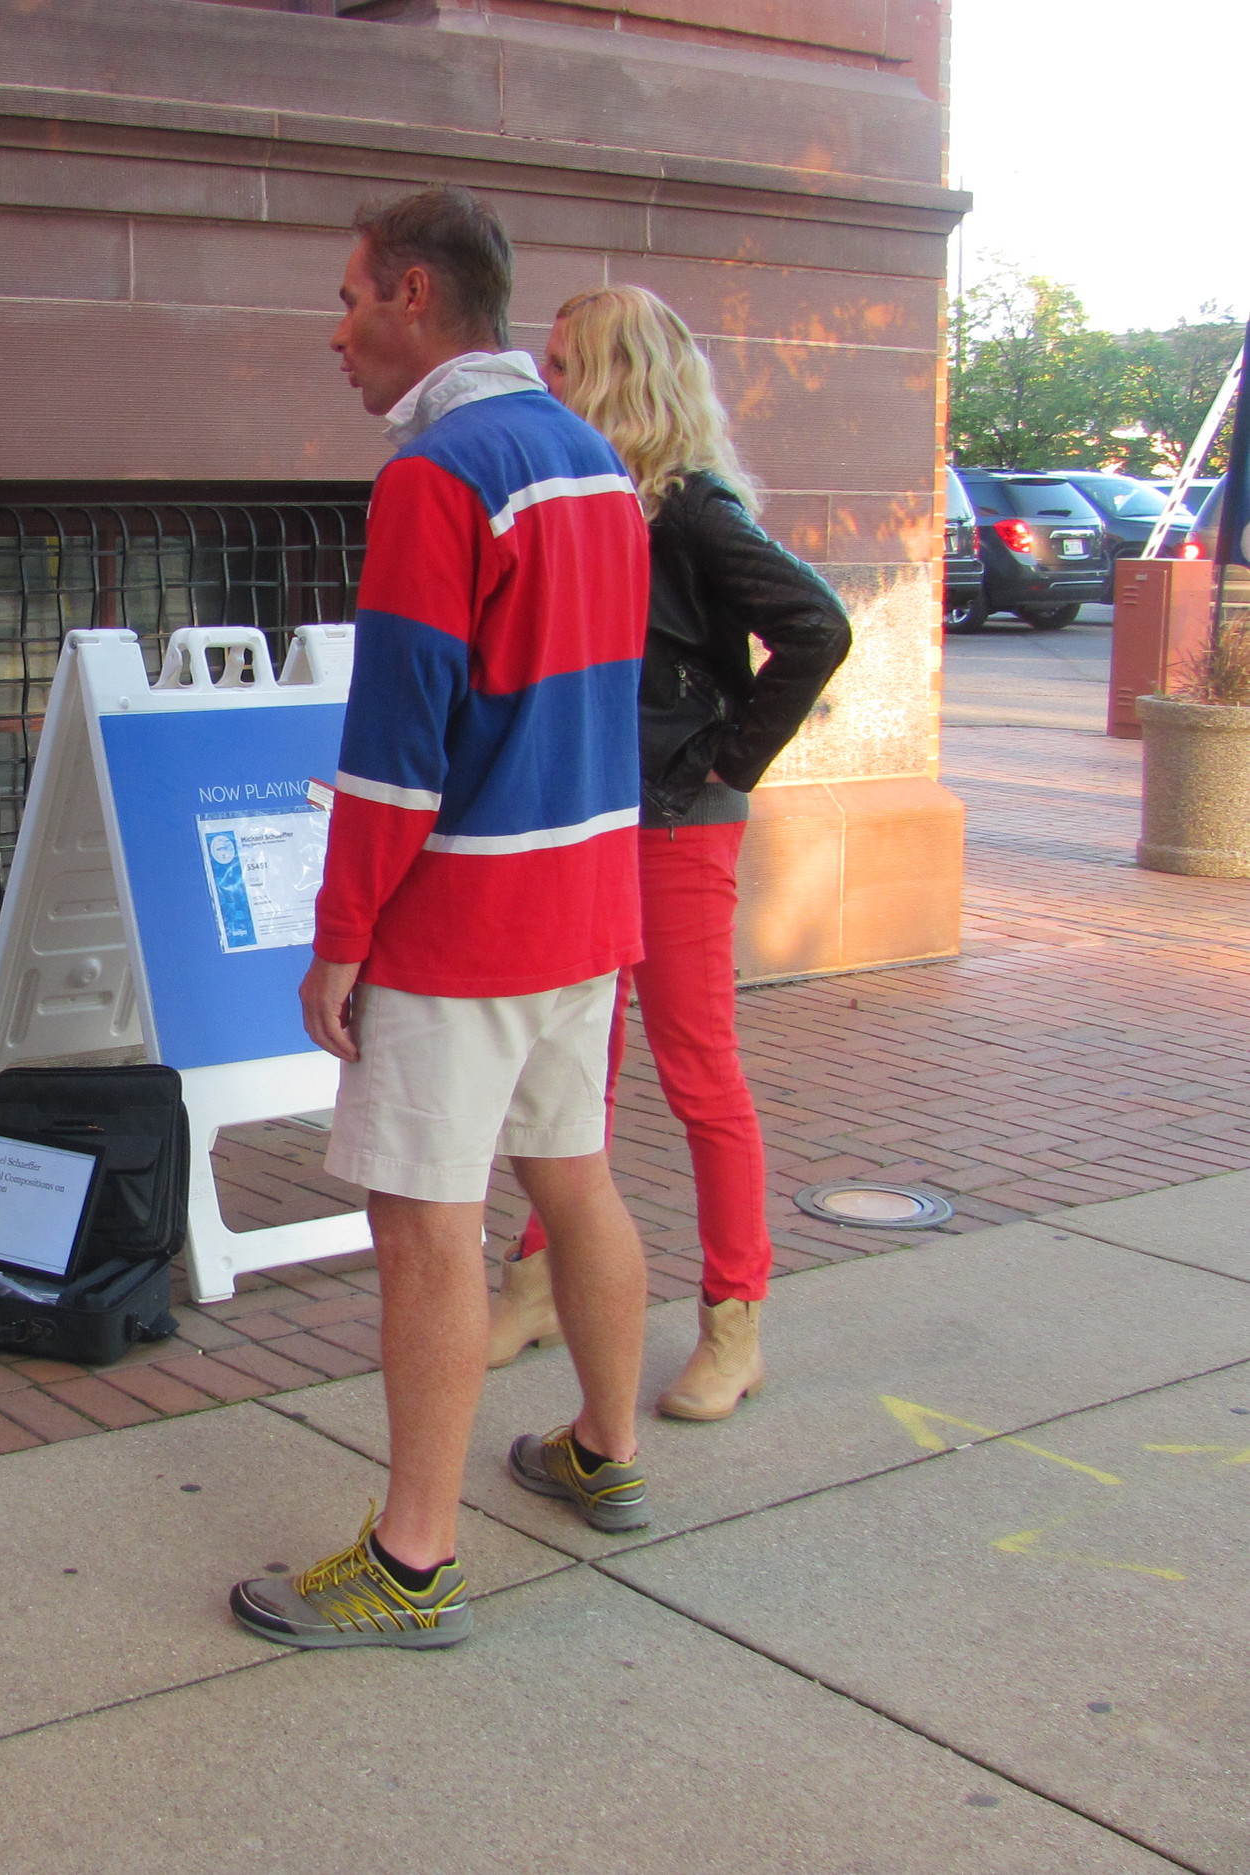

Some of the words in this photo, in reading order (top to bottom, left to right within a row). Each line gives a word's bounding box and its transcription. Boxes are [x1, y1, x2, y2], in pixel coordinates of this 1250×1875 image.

[199, 785, 240, 803] NOW
[240, 834, 264, 843] Michael
[7, 1157, 42, 1172] Schaeffer
[4, 1172, 54, 1191] Compositions
[54, 1184, 65, 1193] on
